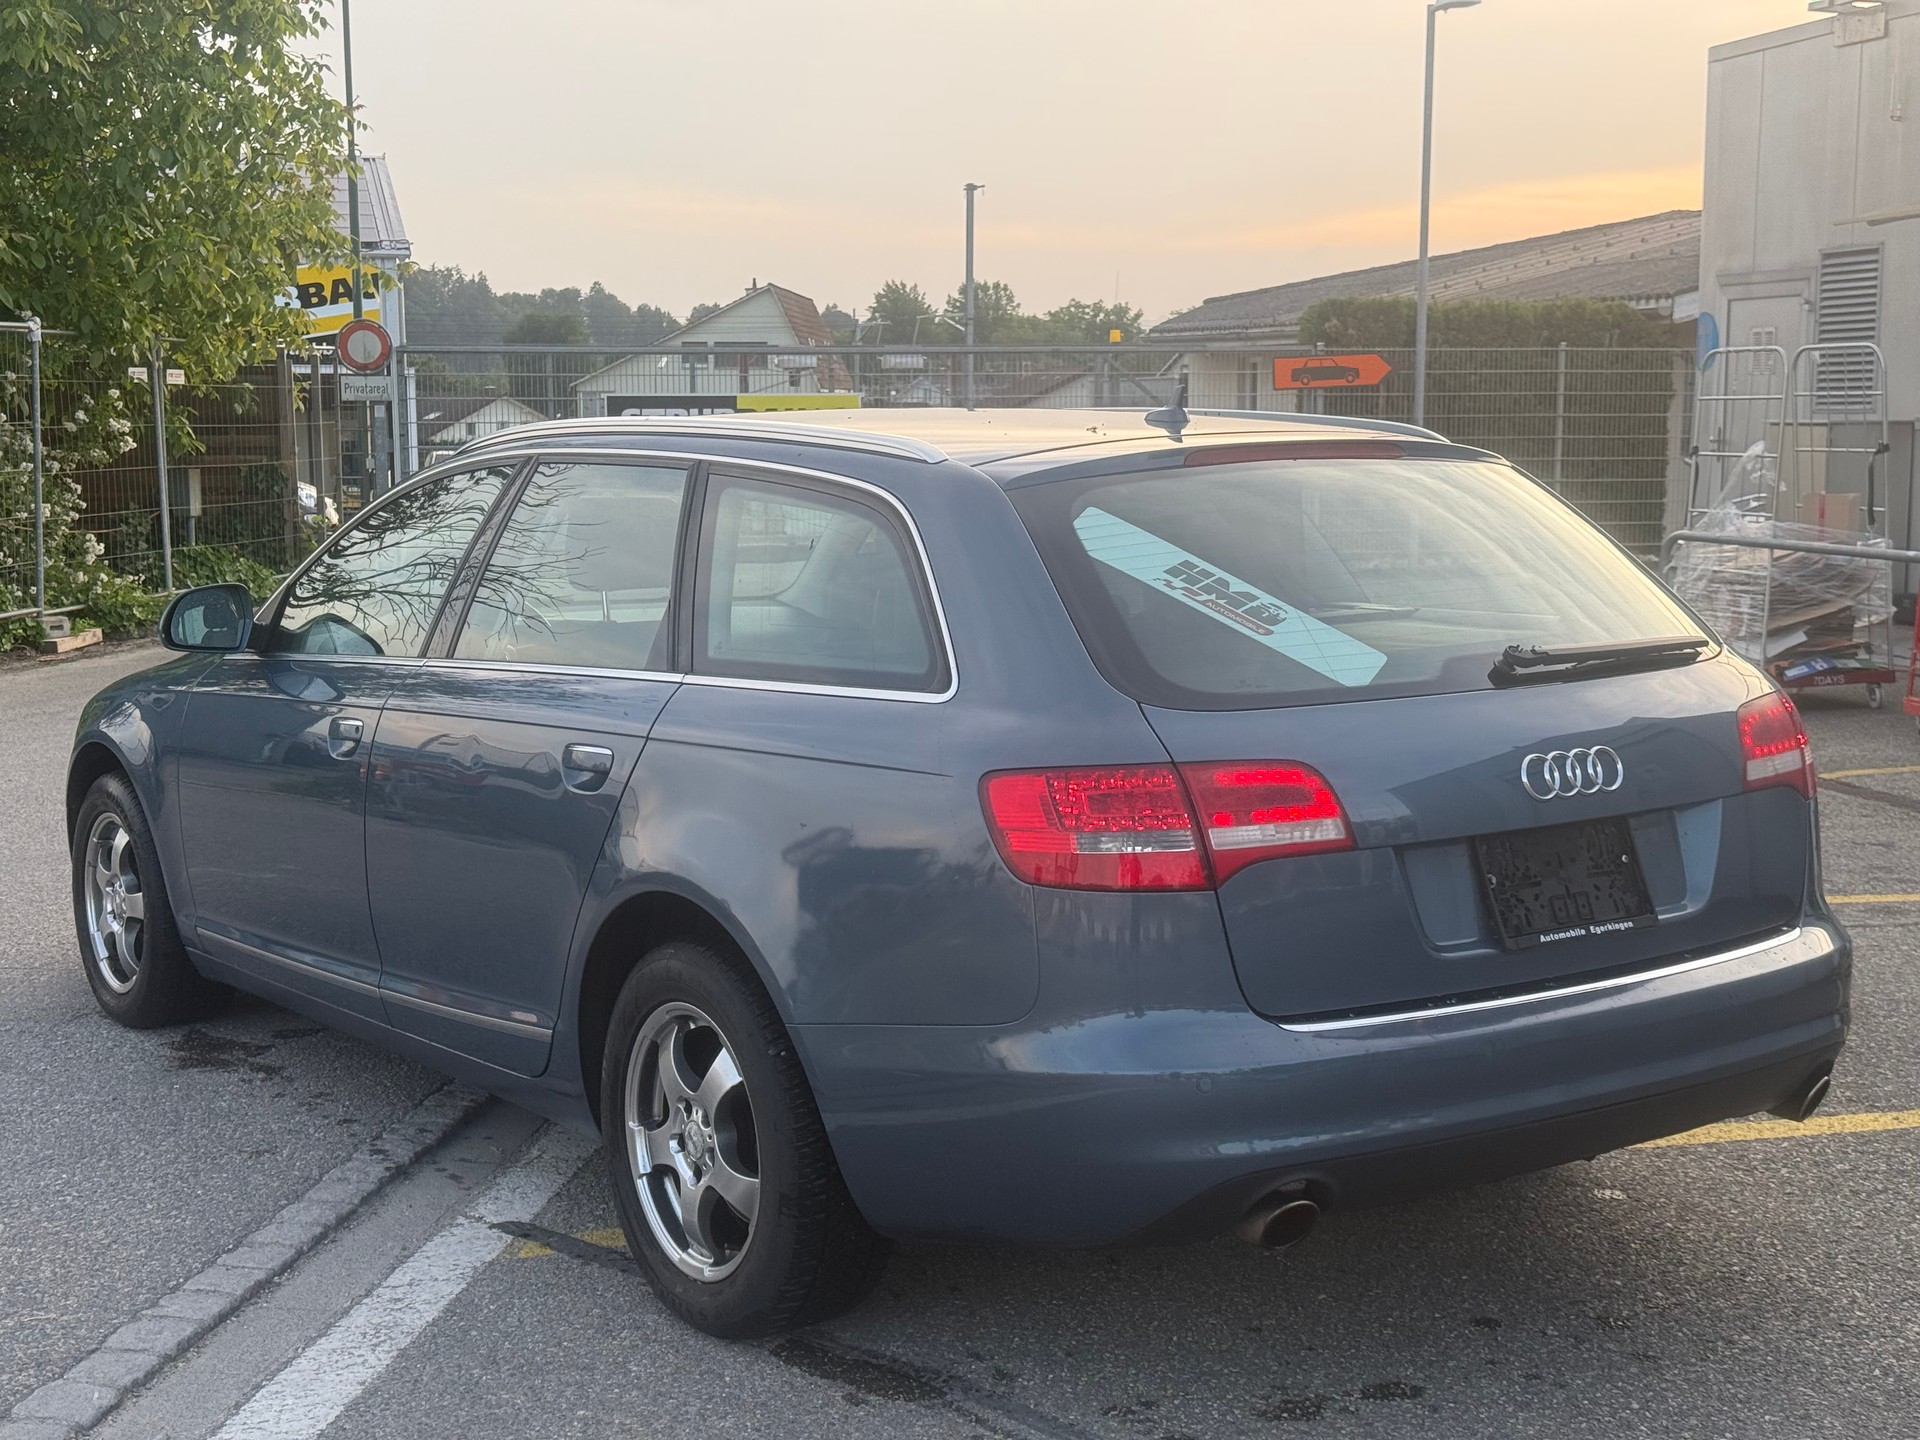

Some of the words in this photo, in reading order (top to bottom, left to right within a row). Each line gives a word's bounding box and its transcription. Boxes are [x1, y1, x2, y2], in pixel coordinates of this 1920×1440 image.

[344, 382, 389, 395] Privatareal
[1205, 601, 1266, 634] AUTOMOBILE
[1813, 674, 1845, 685] 7DAYS
[1540, 928, 1586, 943] Automobile
[1589, 921, 1634, 934] Egerkingen
